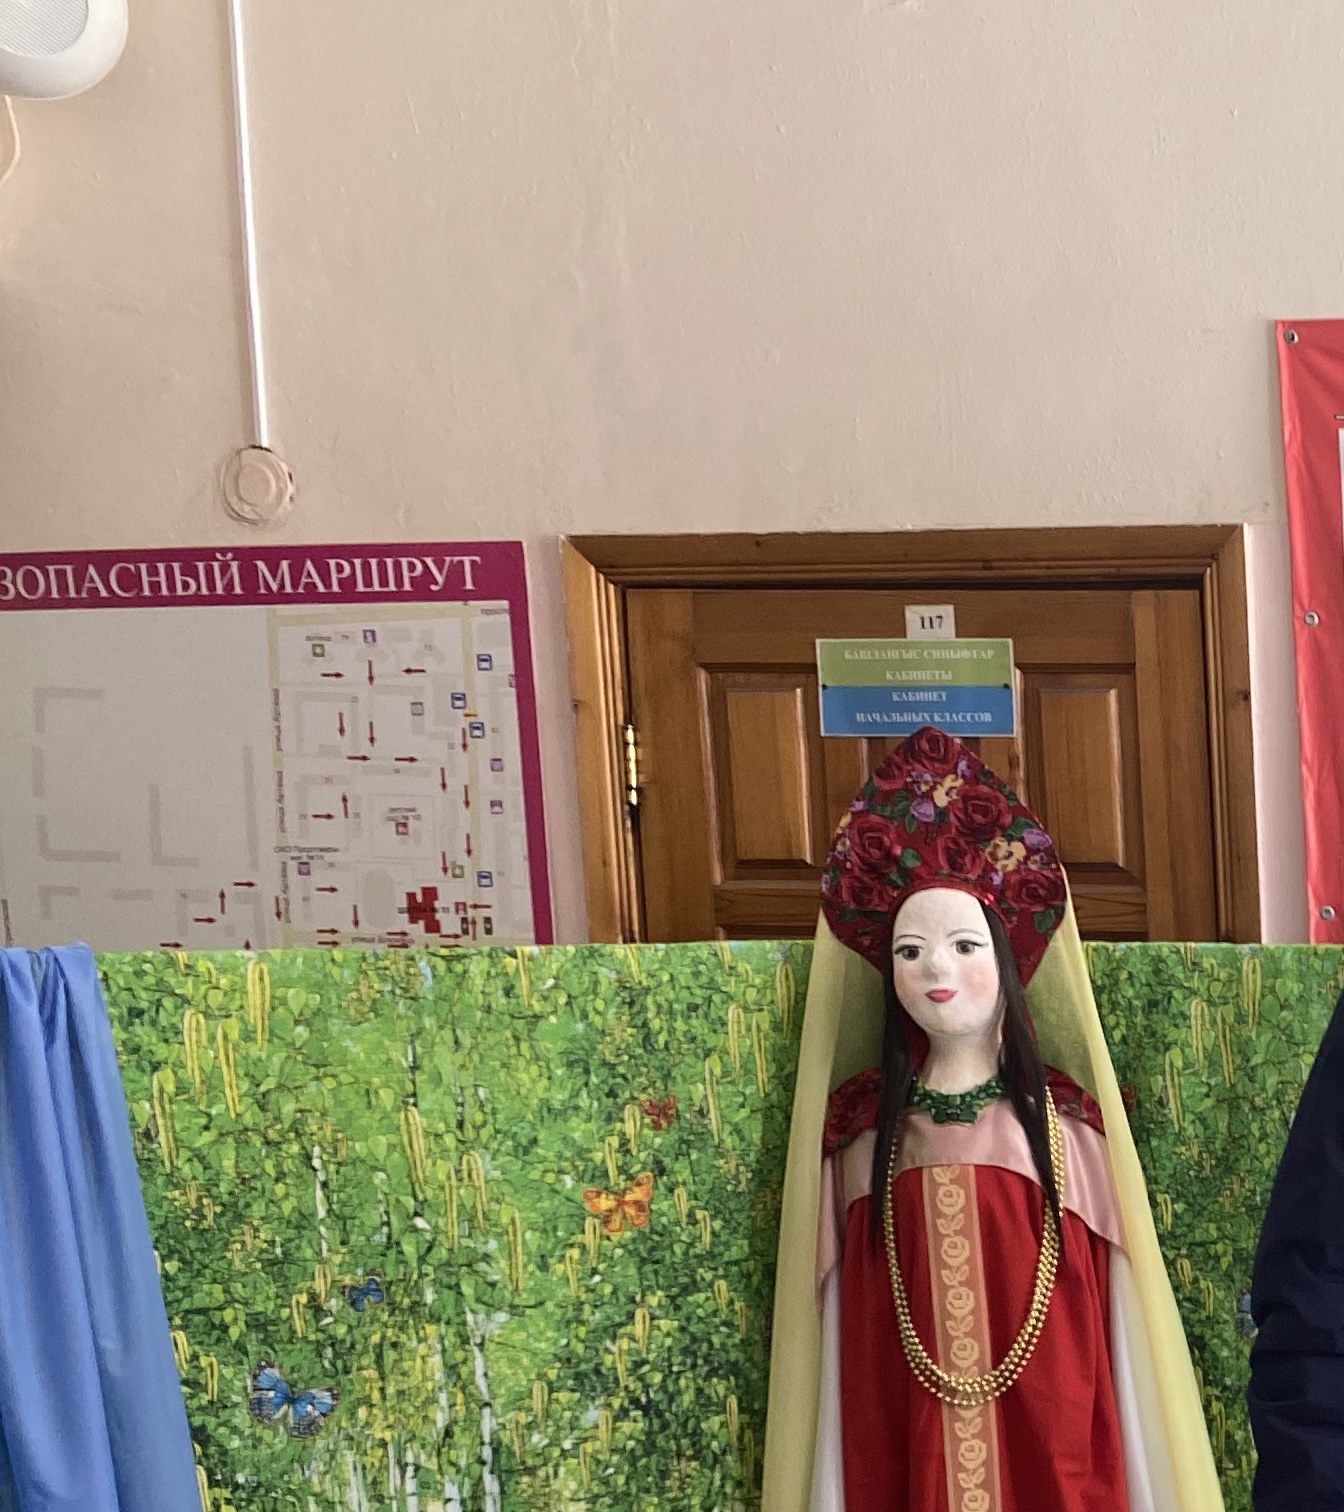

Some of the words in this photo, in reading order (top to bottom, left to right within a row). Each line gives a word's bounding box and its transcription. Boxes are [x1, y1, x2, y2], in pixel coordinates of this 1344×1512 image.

[0, 553, 245, 600] ЗОПАСНЫЙ
[255, 555, 482, 596] МАРШРУТ
[919, 615, 944, 630] 117
[891, 691, 947, 702] КАБИНЕТ
[856, 711, 931, 723] НАЧАЛЬНЫХ
[934, 711, 993, 723] КЛАССОВ
